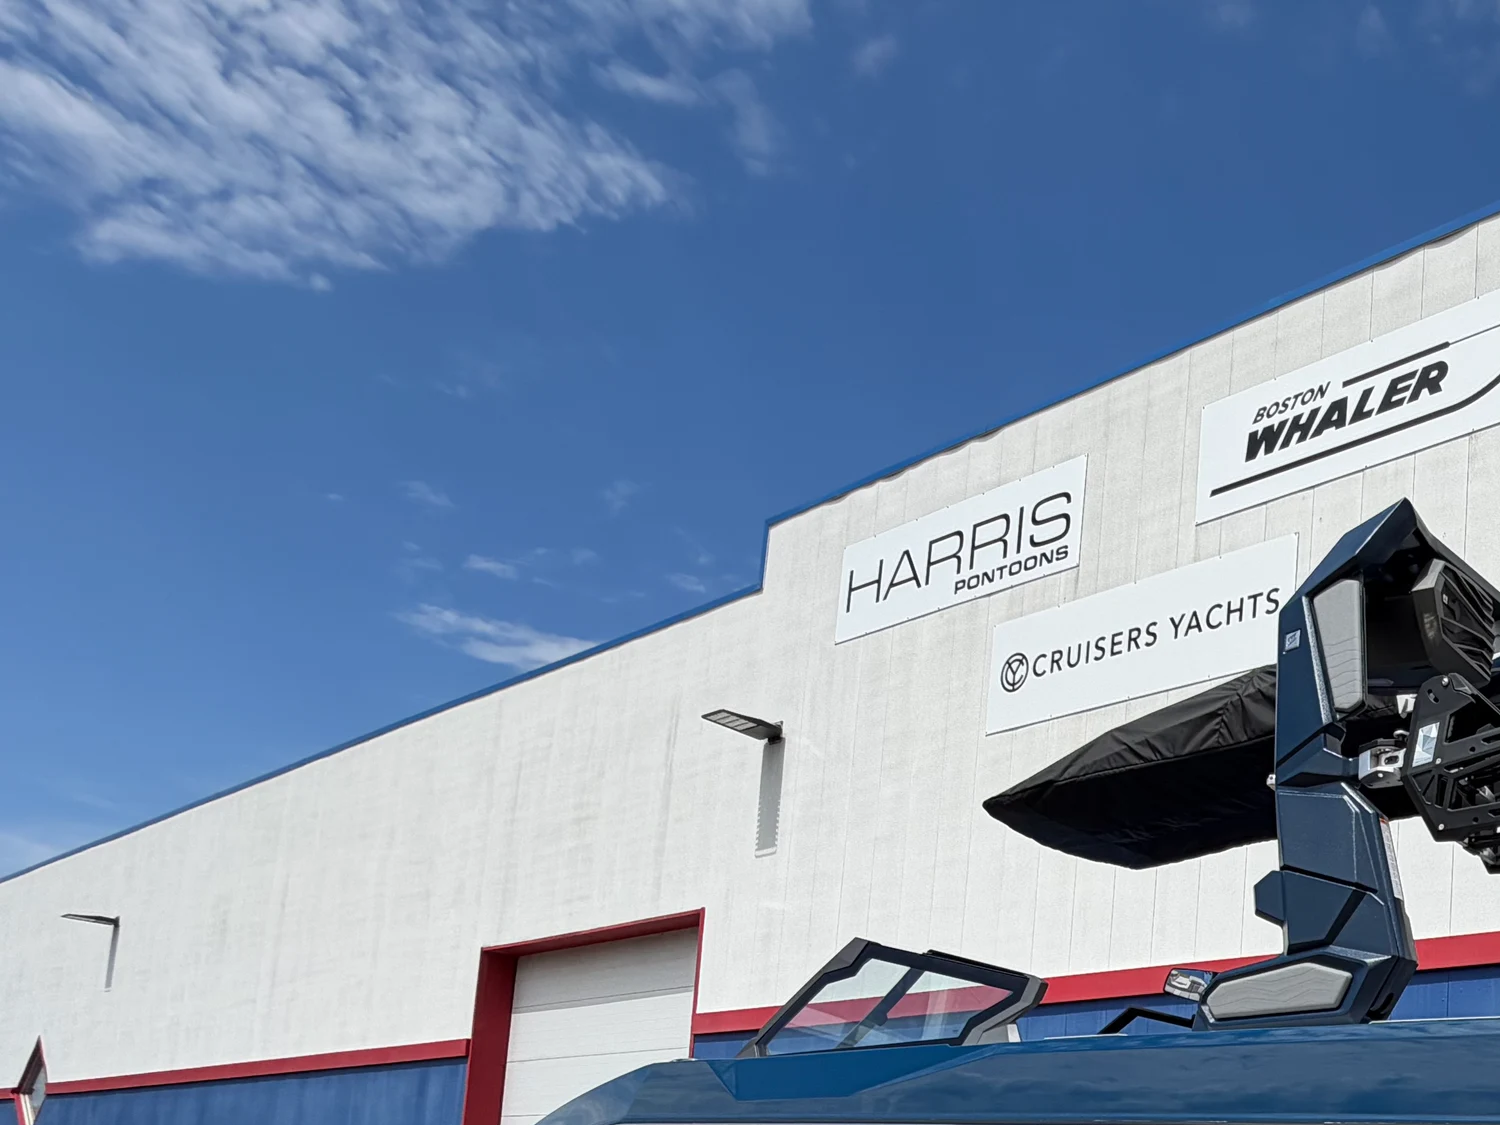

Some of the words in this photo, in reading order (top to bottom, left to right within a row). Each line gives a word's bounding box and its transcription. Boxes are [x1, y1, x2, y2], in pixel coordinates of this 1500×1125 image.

[1243, 360, 1449, 463] WHALER
[1251, 380, 1331, 425] BOSTON
[846, 490, 1073, 614] HARRIS
[953, 545, 1070, 596] PONTOONS
[1031, 621, 1159, 680] CRUISERS
[1168, 587, 1282, 640] YACHTS
